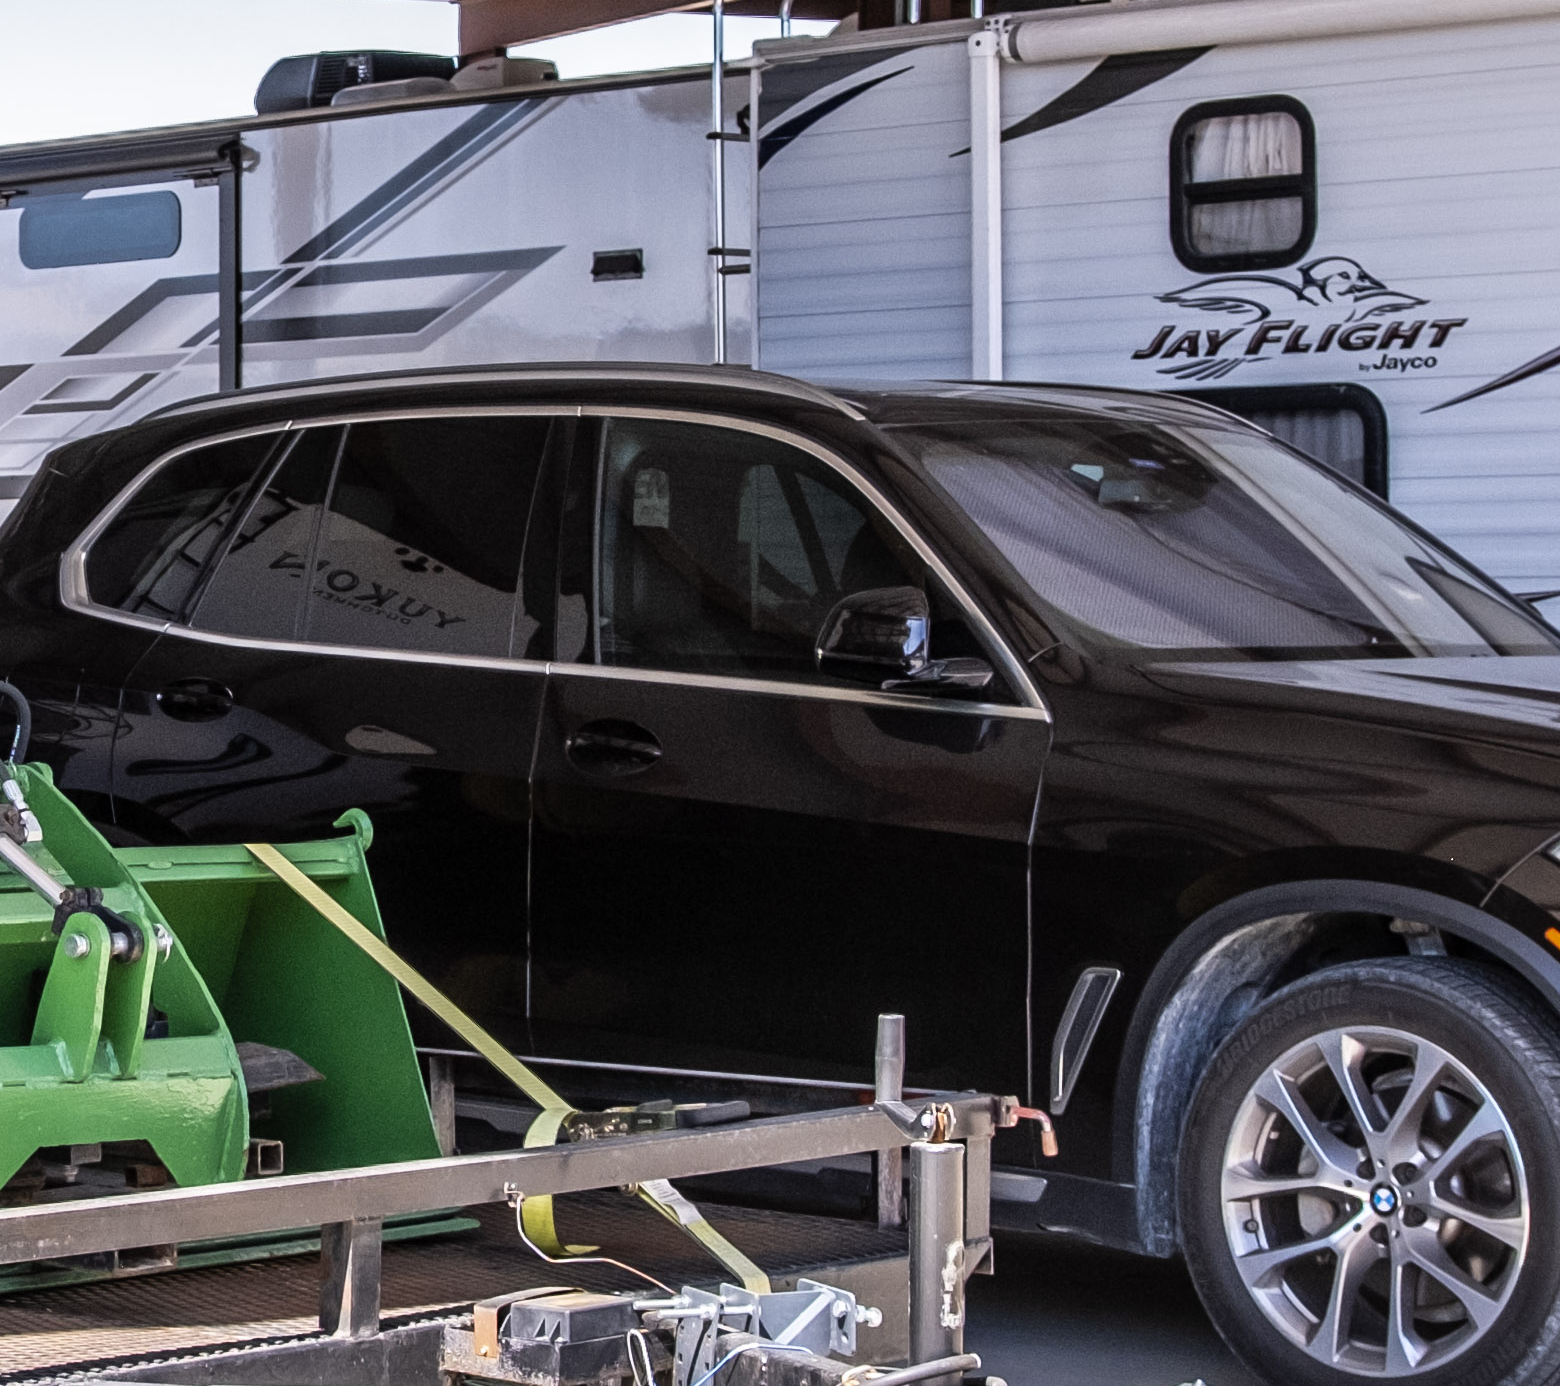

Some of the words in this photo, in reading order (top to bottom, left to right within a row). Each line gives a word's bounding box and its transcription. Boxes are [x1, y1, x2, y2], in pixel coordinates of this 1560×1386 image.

[1131, 325, 1244, 360] JAY
[1245, 318, 1468, 354] FLIGHT
[1372, 352, 1438, 374] Jayco
